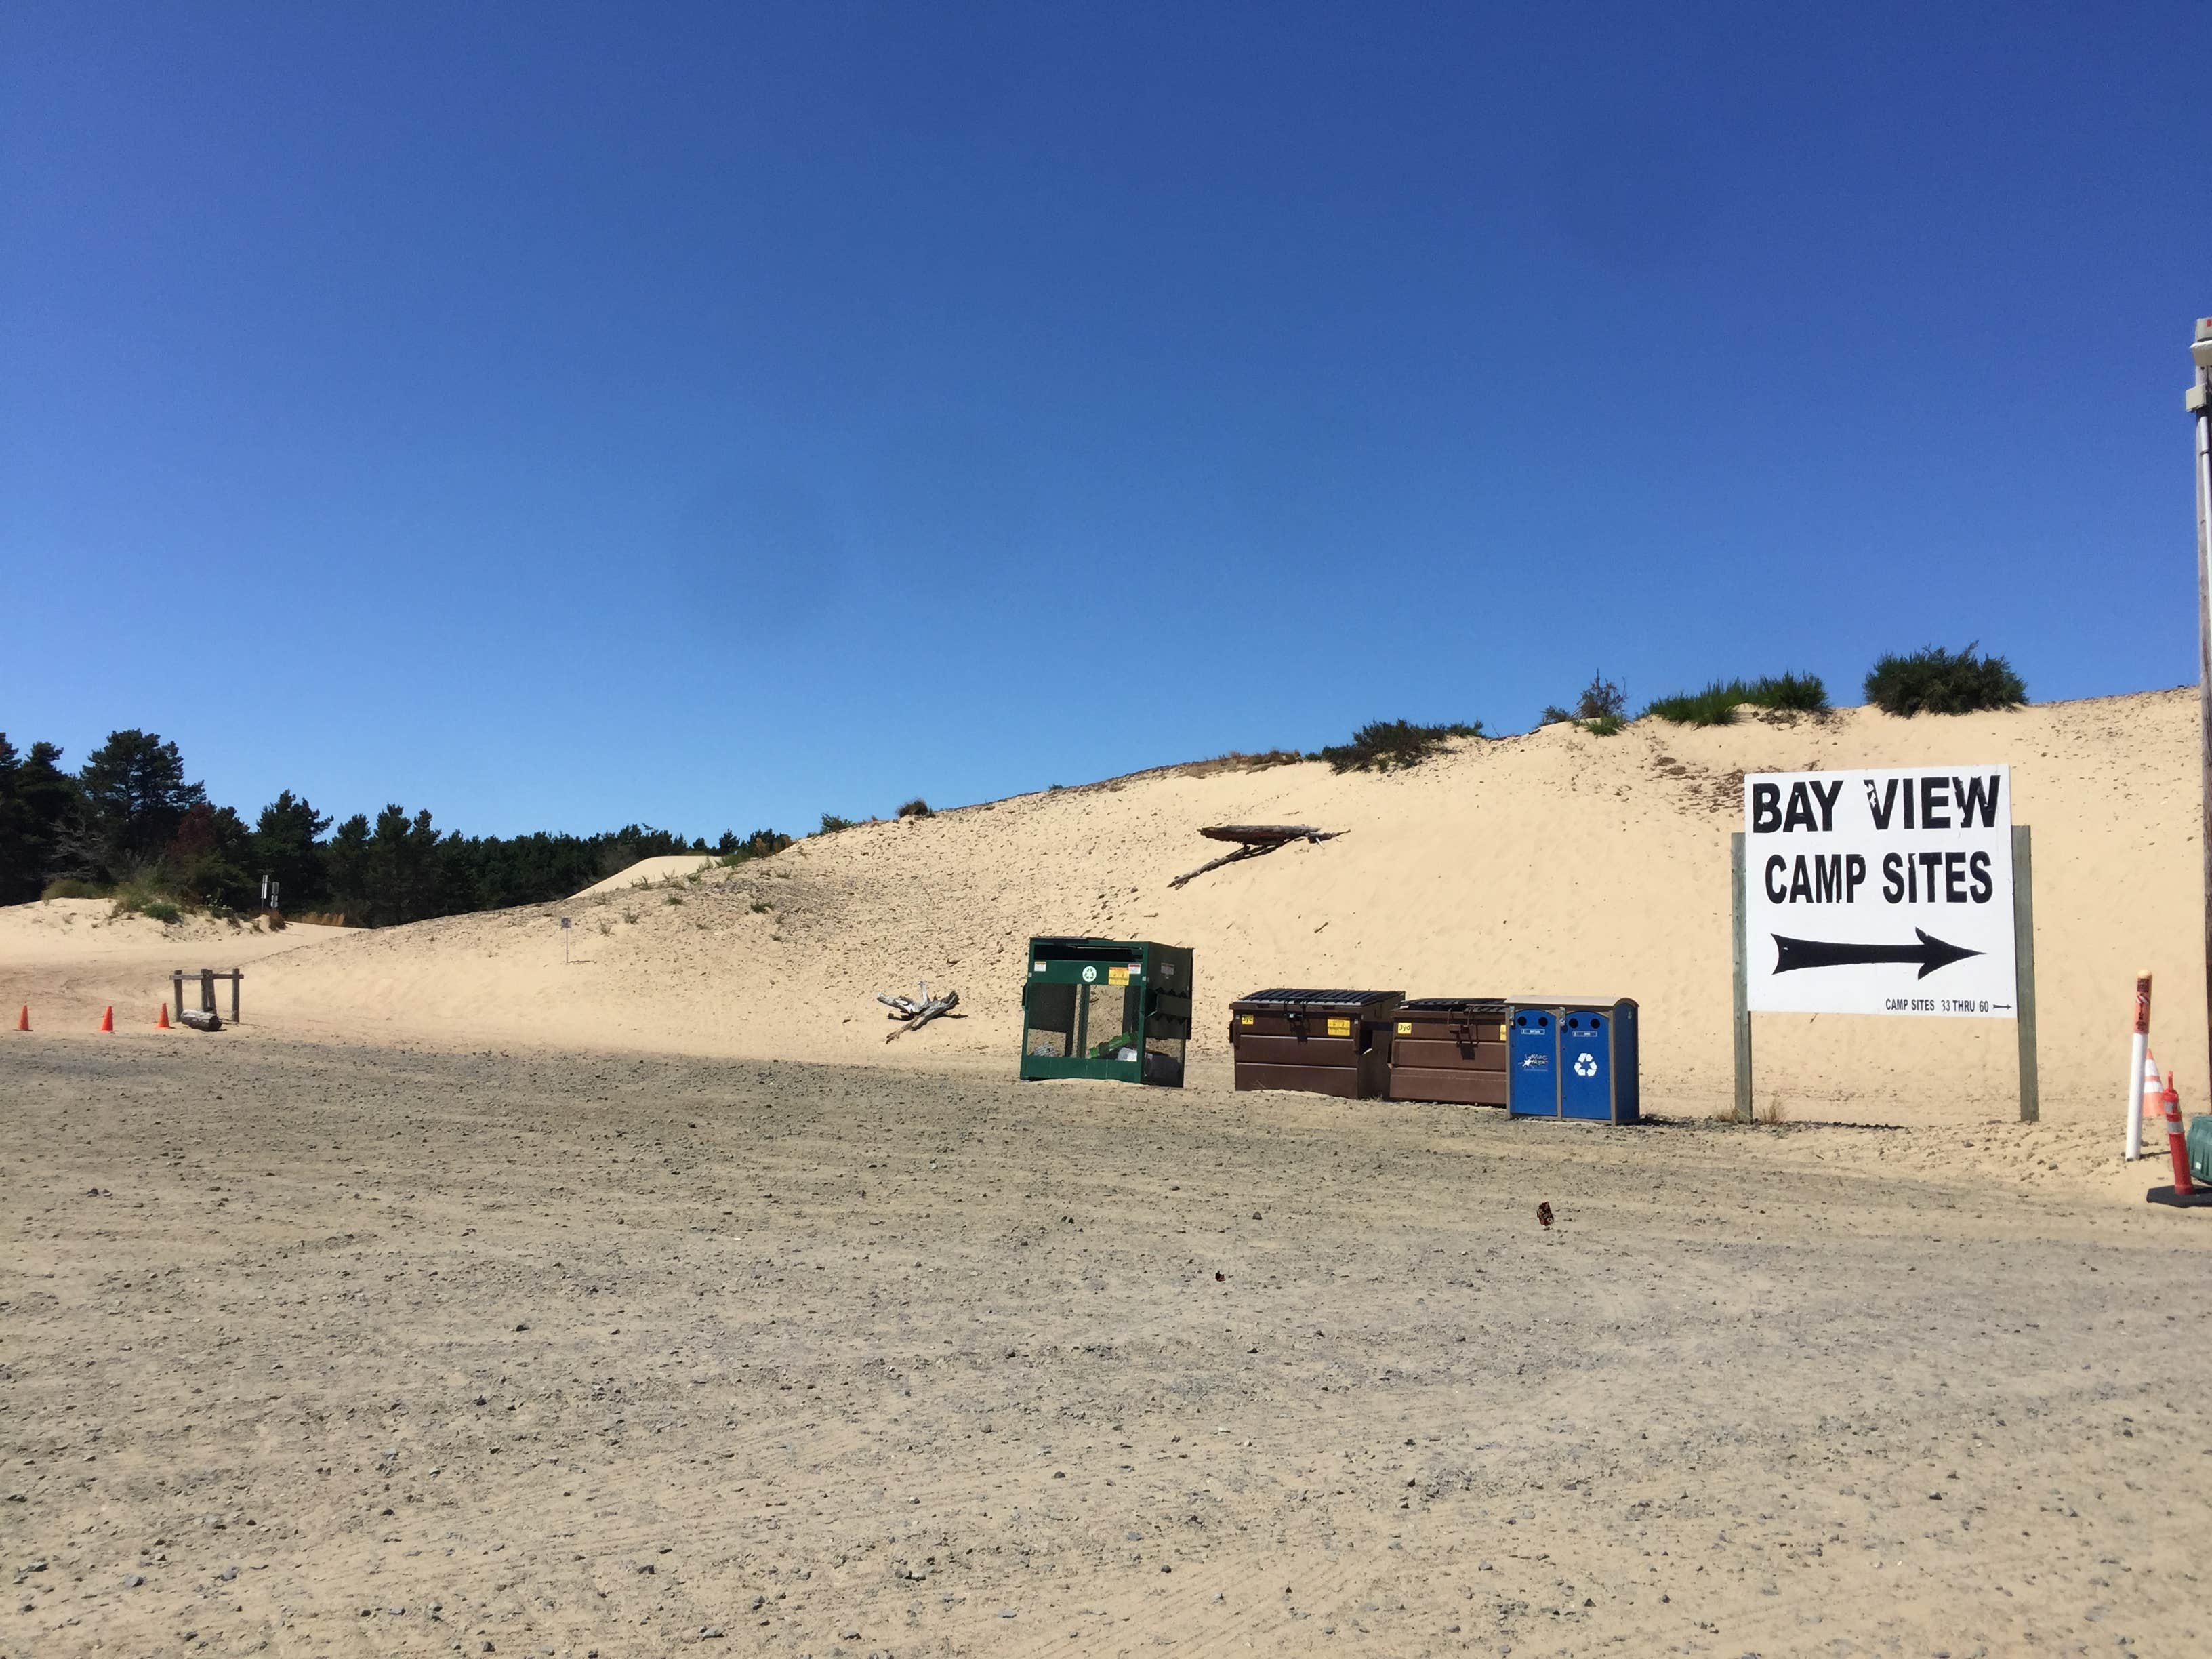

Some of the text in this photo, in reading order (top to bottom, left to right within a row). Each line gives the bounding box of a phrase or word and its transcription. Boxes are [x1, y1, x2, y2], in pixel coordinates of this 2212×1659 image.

[1753, 775, 2001, 834] BAY VIEW
[1765, 851, 1993, 904] CAMP SITES
[1885, 998, 1989, 1012] CAMP SITES 33 THRU 60
[1399, 1024, 1411, 1032] 3yd
